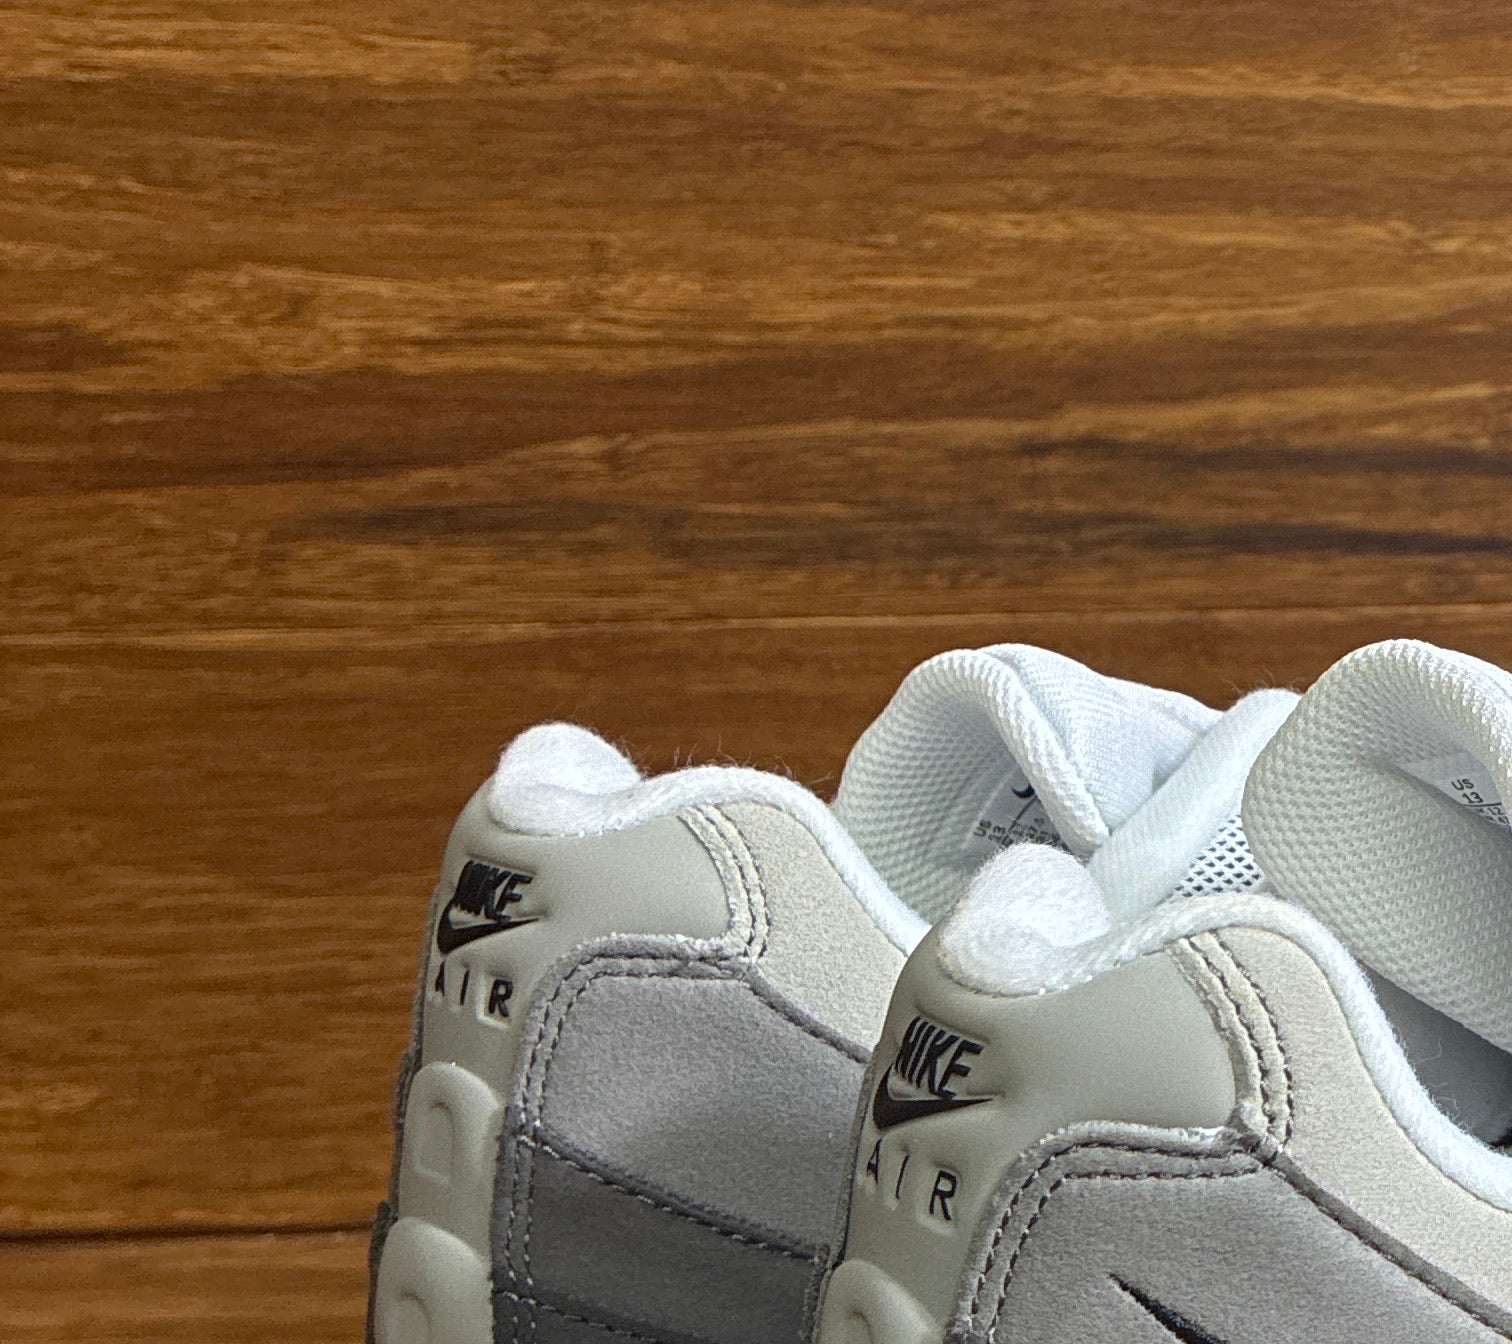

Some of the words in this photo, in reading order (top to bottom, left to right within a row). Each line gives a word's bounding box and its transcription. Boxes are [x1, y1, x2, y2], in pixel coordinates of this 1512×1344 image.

[1451, 778, 1475, 791] US
[1462, 791, 1484, 804] 13
[452, 859, 534, 922] NIKE
[434, 960, 514, 1018] AIR
[894, 1015, 984, 1099] NIKE
[866, 1137, 958, 1221] AIR
